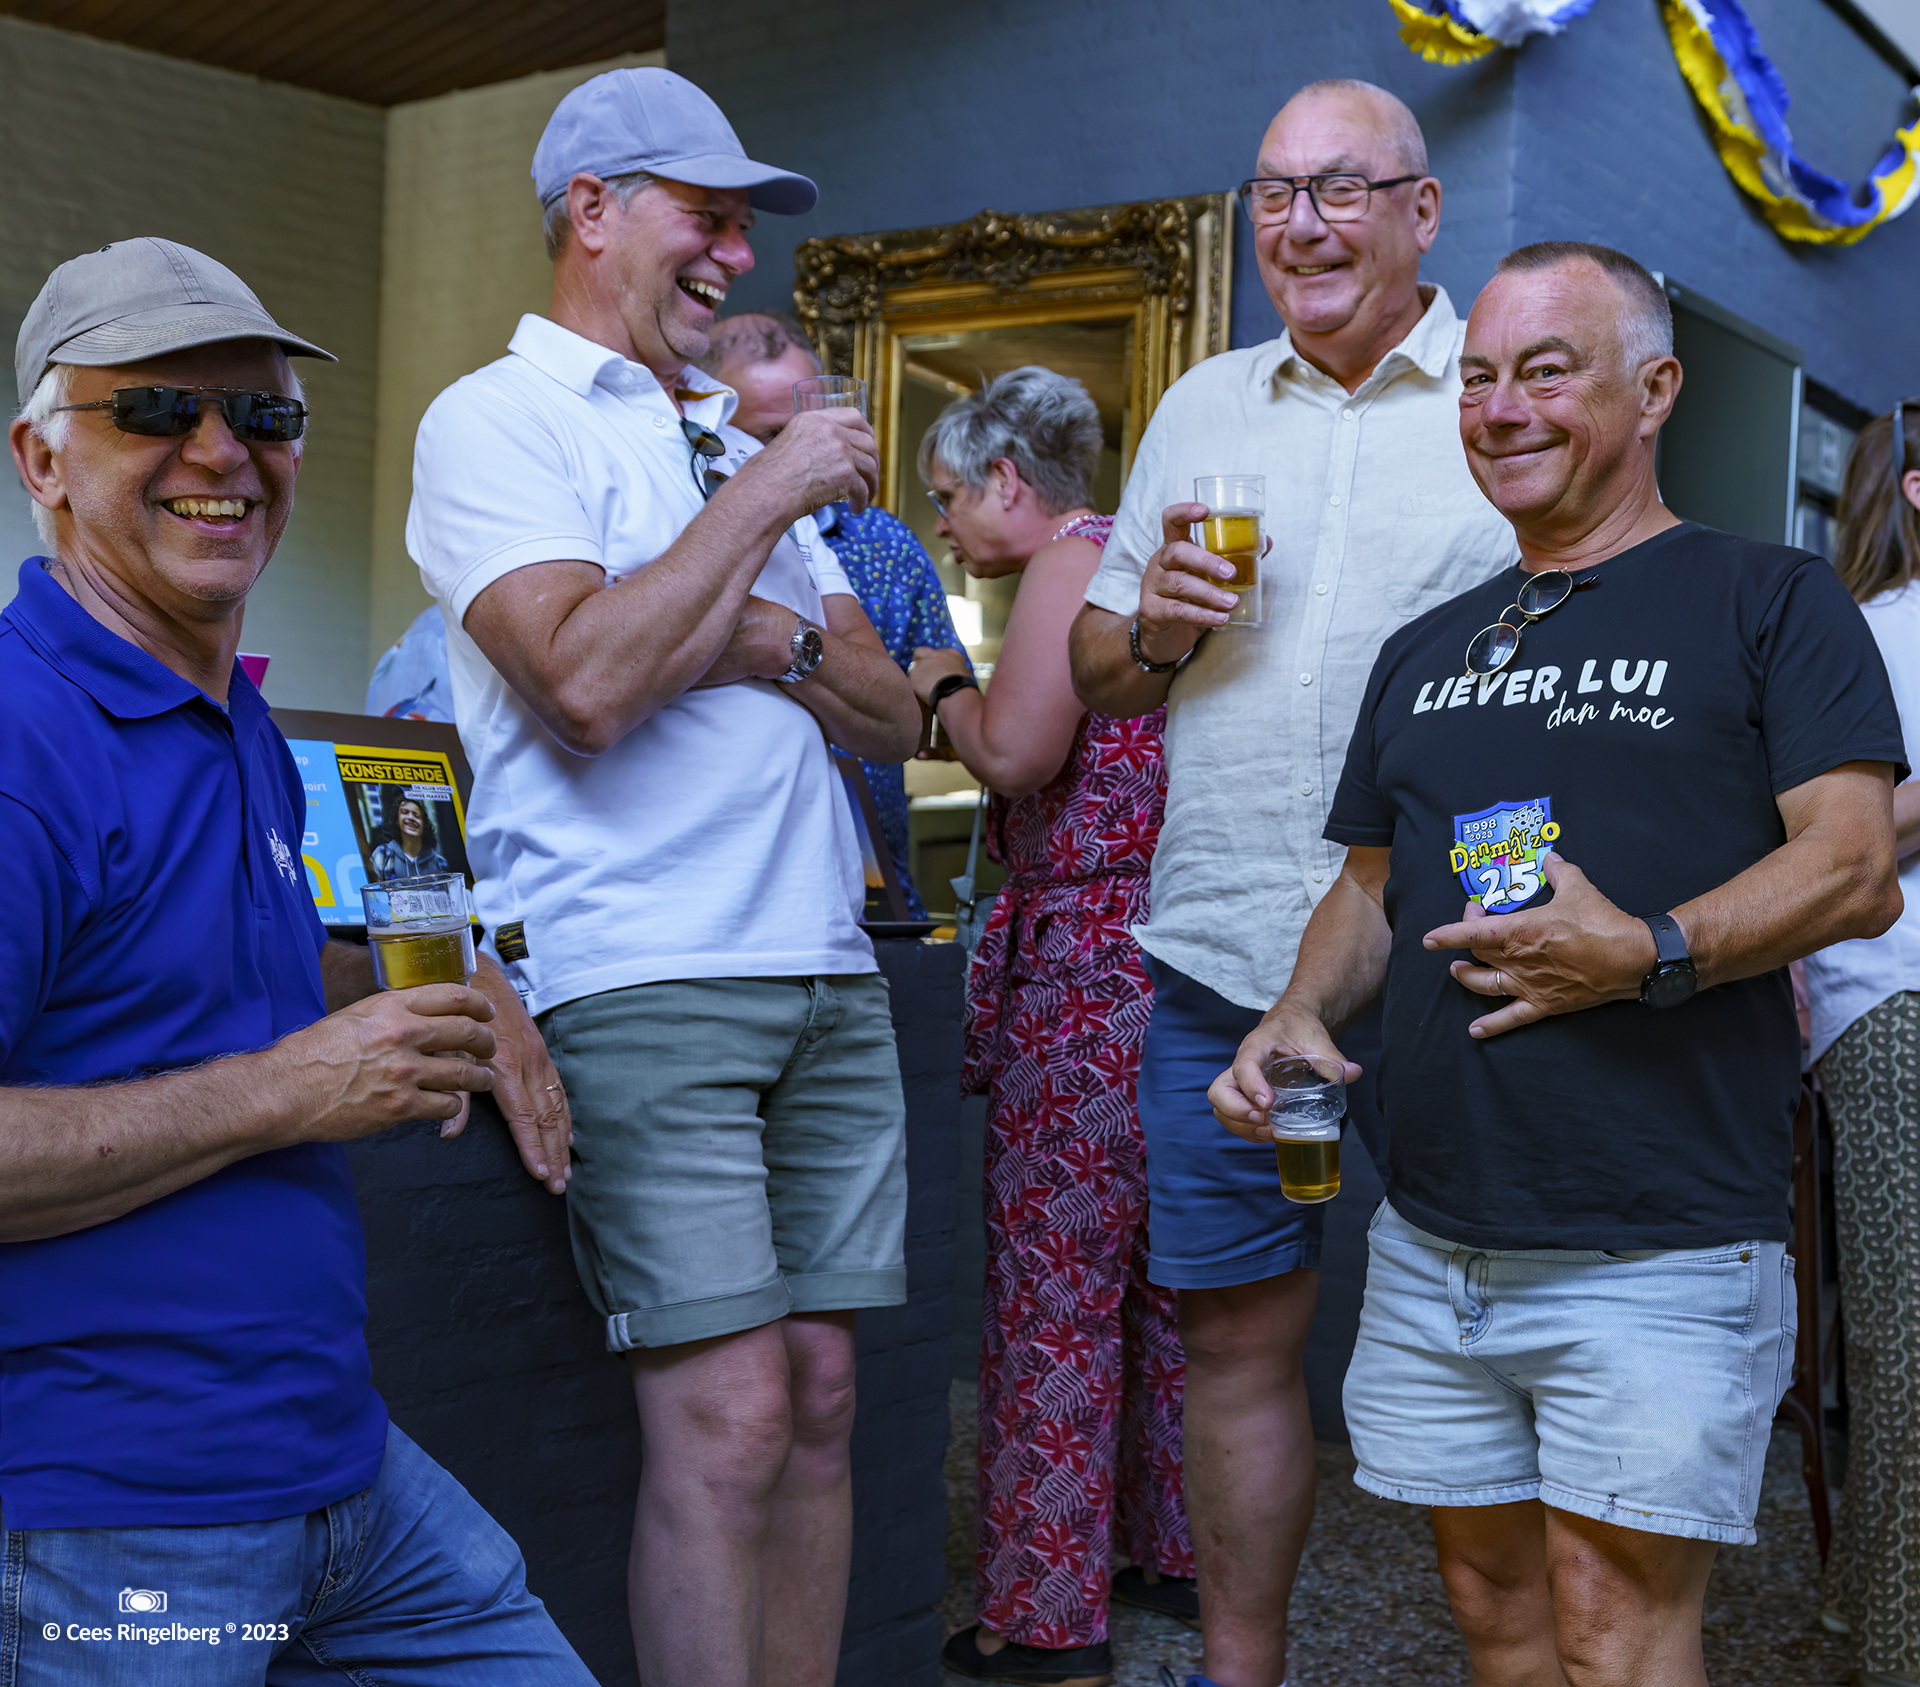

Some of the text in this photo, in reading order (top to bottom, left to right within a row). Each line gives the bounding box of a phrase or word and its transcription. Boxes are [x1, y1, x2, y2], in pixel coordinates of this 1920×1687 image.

[1413, 659, 1669, 715] LIEVER LUI
[1546, 691, 1674, 730] dan moe
[338, 762, 445, 783] KUNSTBENDE
[1464, 818, 1497, 834] 1998
[1469, 830, 1494, 842] 2023
[1477, 860, 1541, 911] 25
